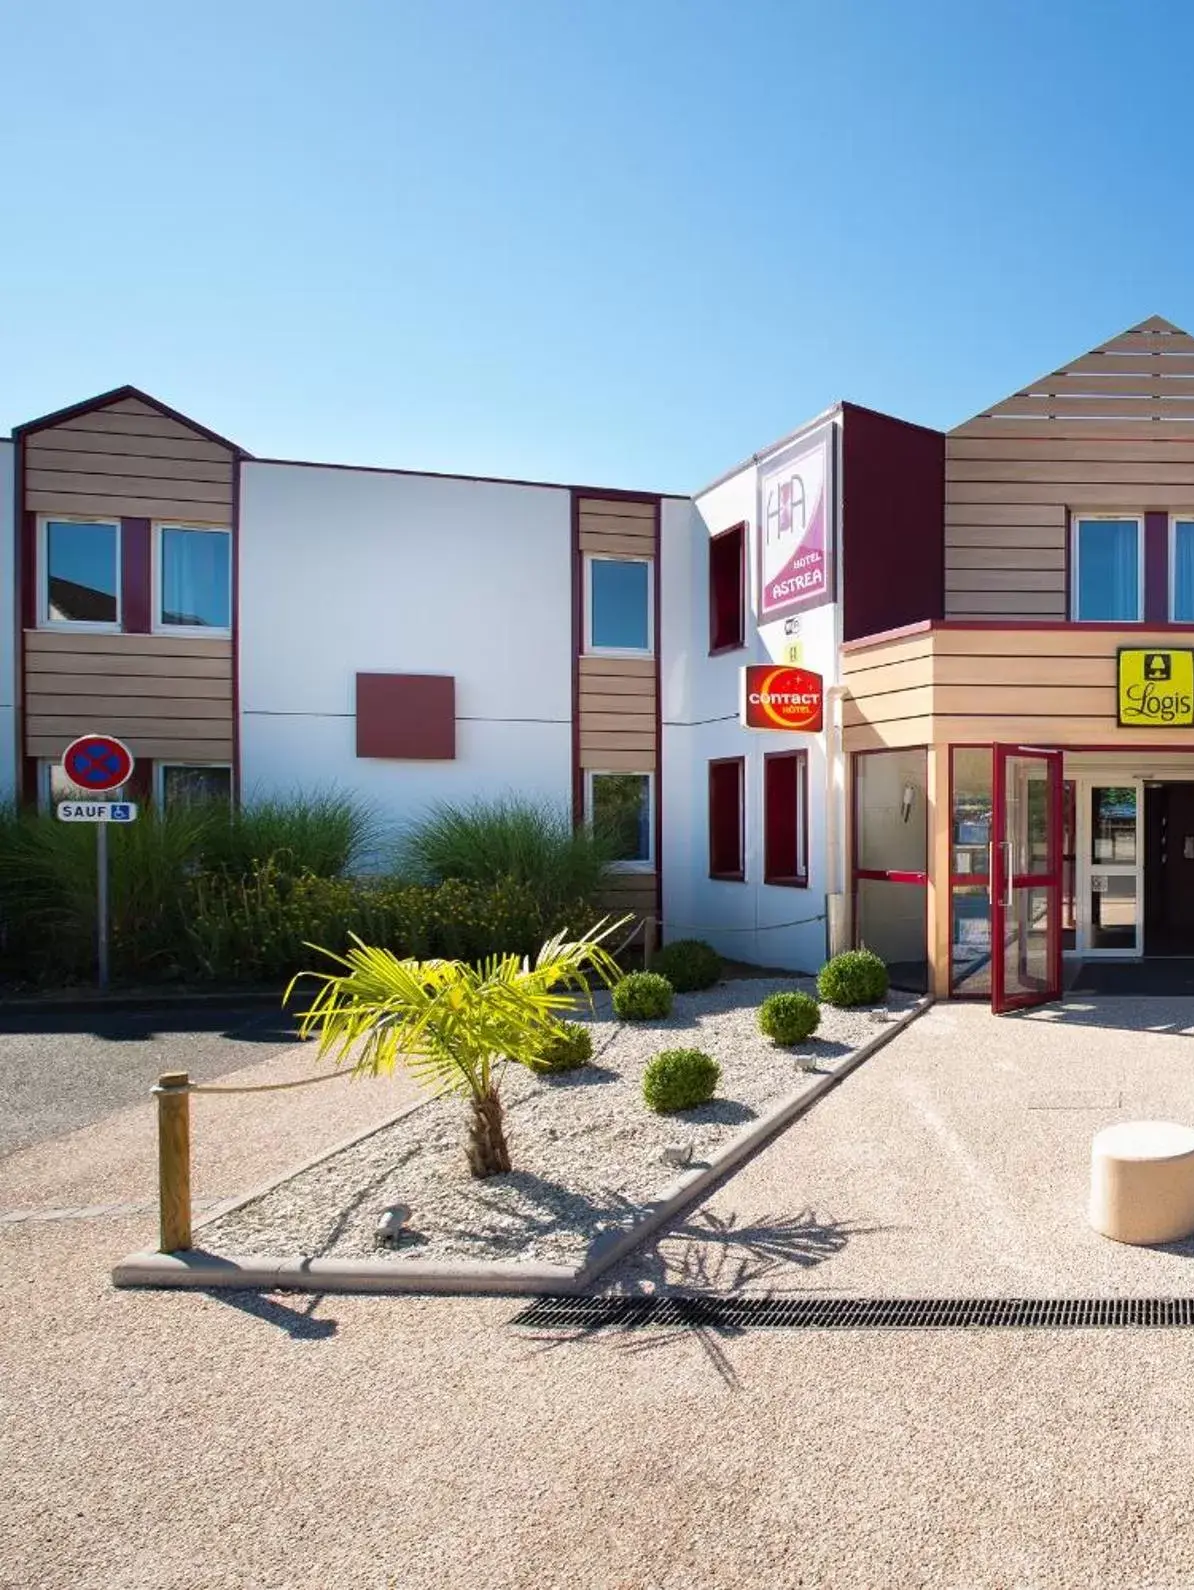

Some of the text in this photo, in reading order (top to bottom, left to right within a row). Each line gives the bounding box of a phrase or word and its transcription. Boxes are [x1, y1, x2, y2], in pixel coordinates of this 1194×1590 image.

[793, 551, 822, 569] HOTEL
[772, 568, 822, 599] ASTREA
[1122, 682, 1191, 722] Logis
[62, 805, 106, 818] SAUF
